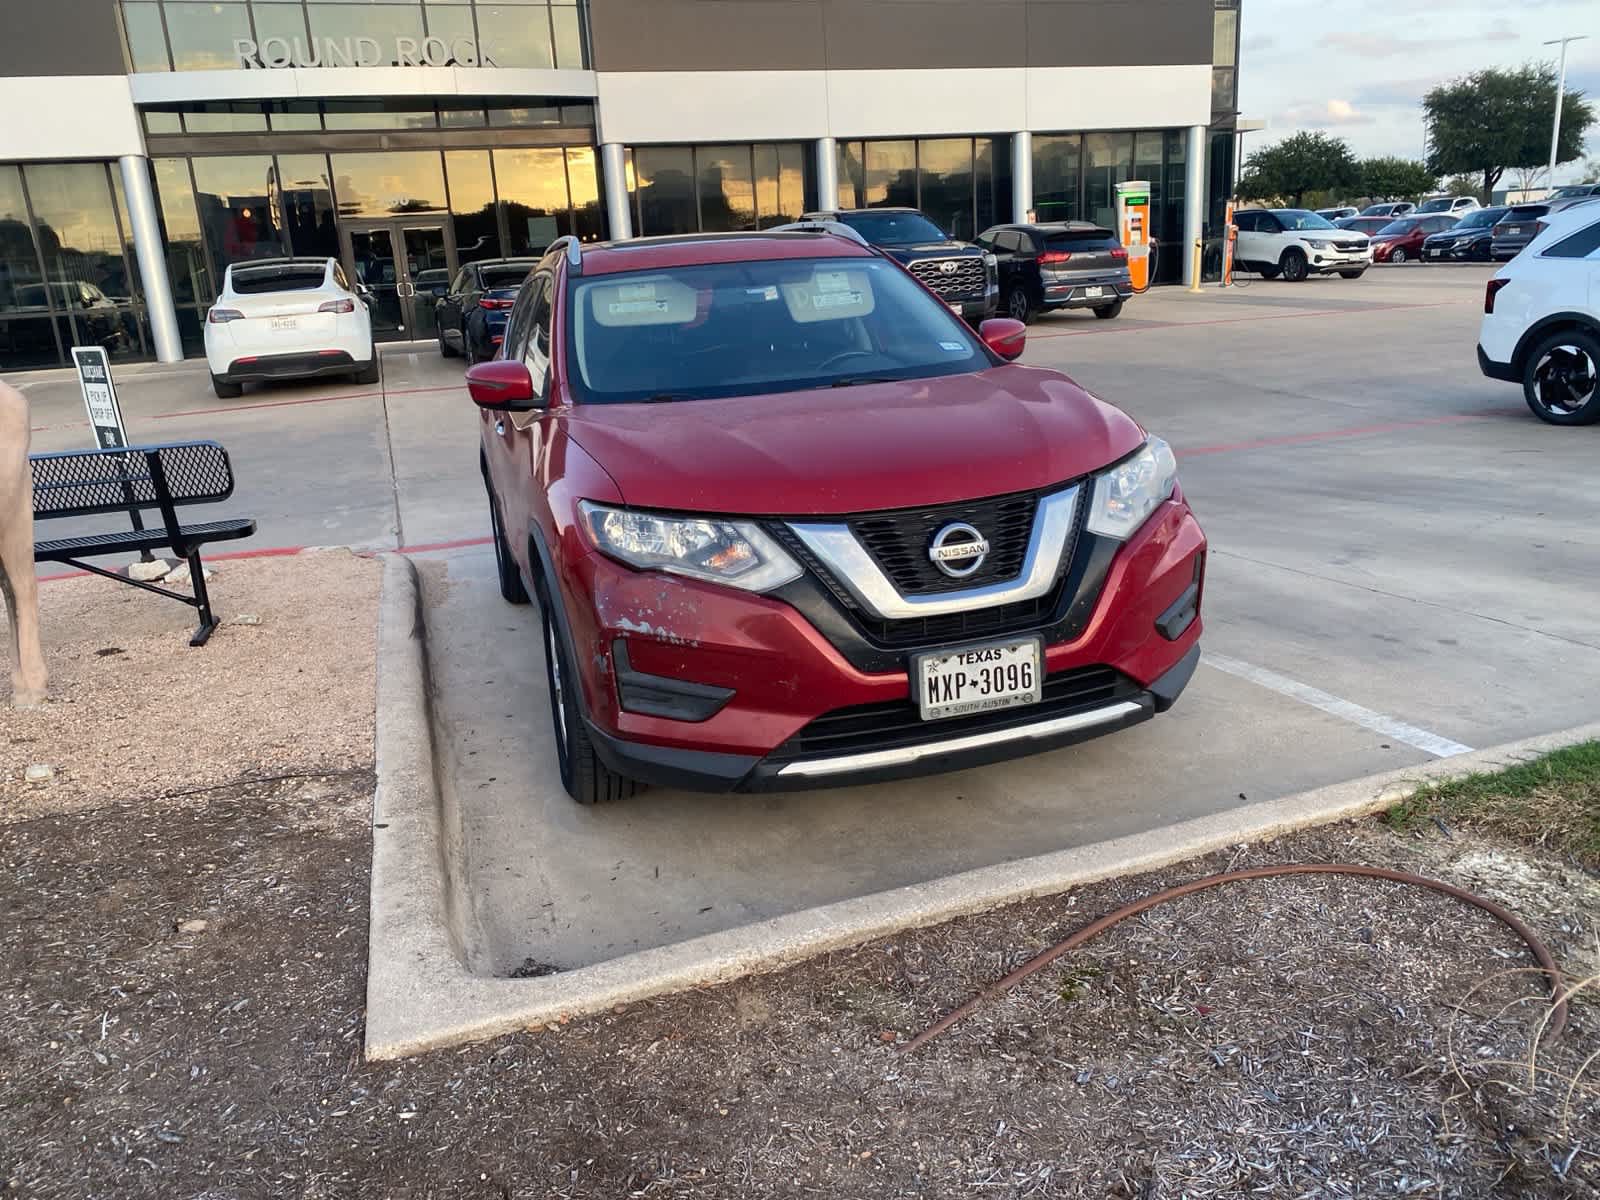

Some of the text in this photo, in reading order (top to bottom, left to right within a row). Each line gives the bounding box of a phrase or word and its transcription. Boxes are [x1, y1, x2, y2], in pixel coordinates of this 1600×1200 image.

[234, 37, 498, 69] ROUND ROCK
[937, 544, 985, 558] NISSAN
[958, 649, 1002, 665] TEXAS
[928, 662, 1032, 704] MXP 3096
[952, 698, 1011, 714] SOUTH AUSTIN
